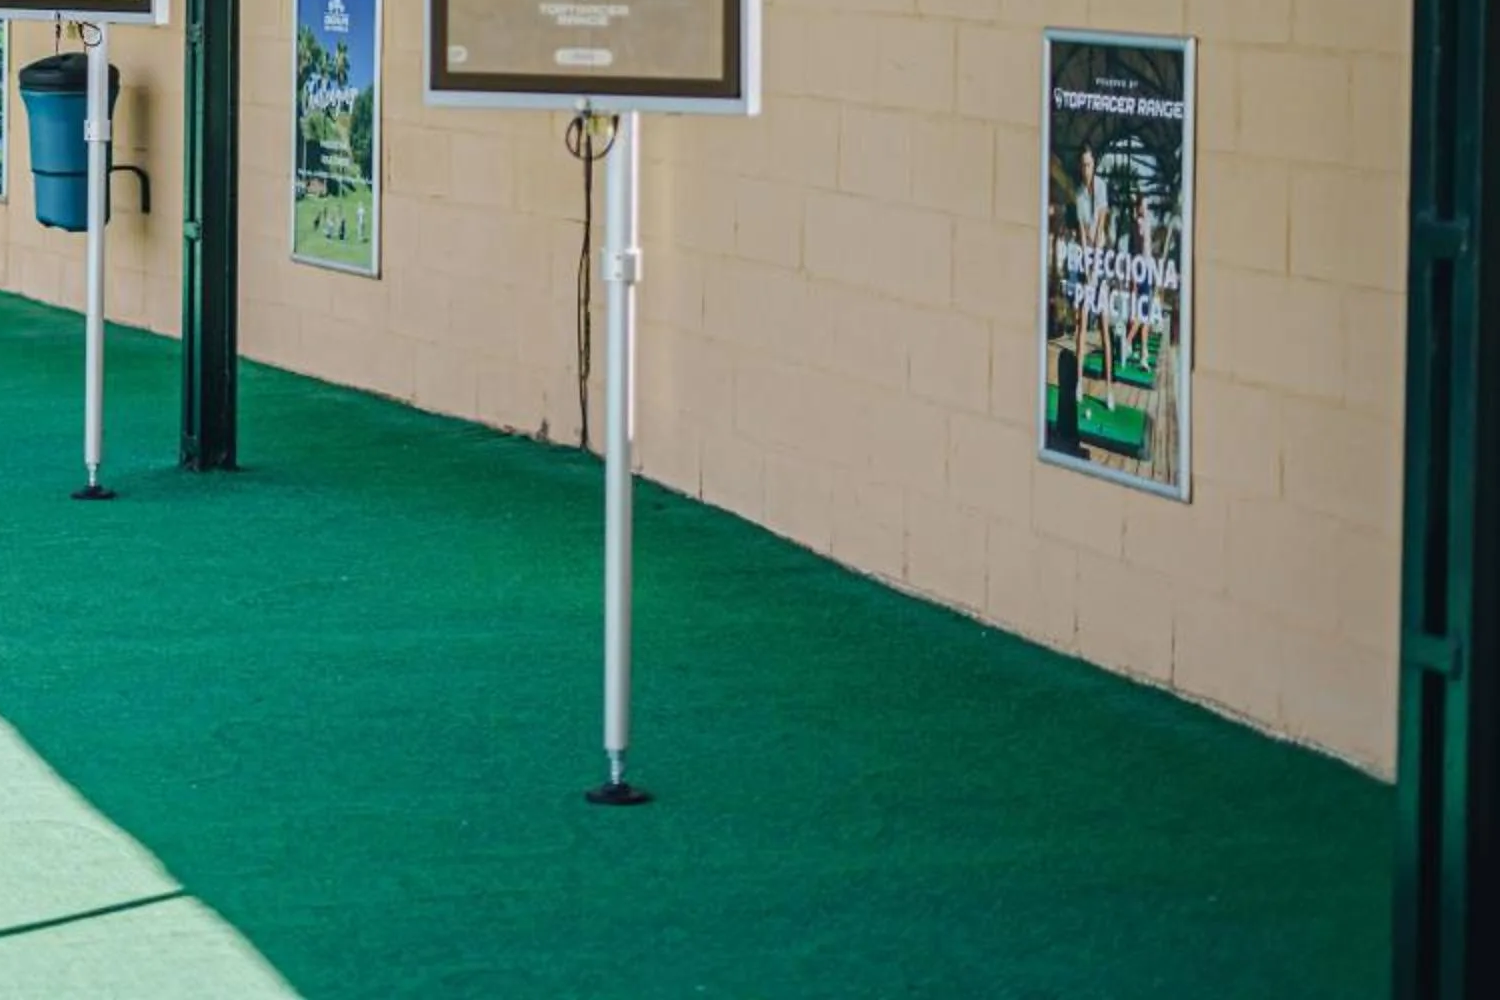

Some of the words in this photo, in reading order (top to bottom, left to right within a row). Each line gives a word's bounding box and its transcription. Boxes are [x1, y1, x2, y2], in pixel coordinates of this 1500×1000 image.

[1064, 91, 1136, 115] TOPTRACER
[1137, 97, 1185, 119] RANGE
[1056, 238, 1179, 289] PERFECCIONA
